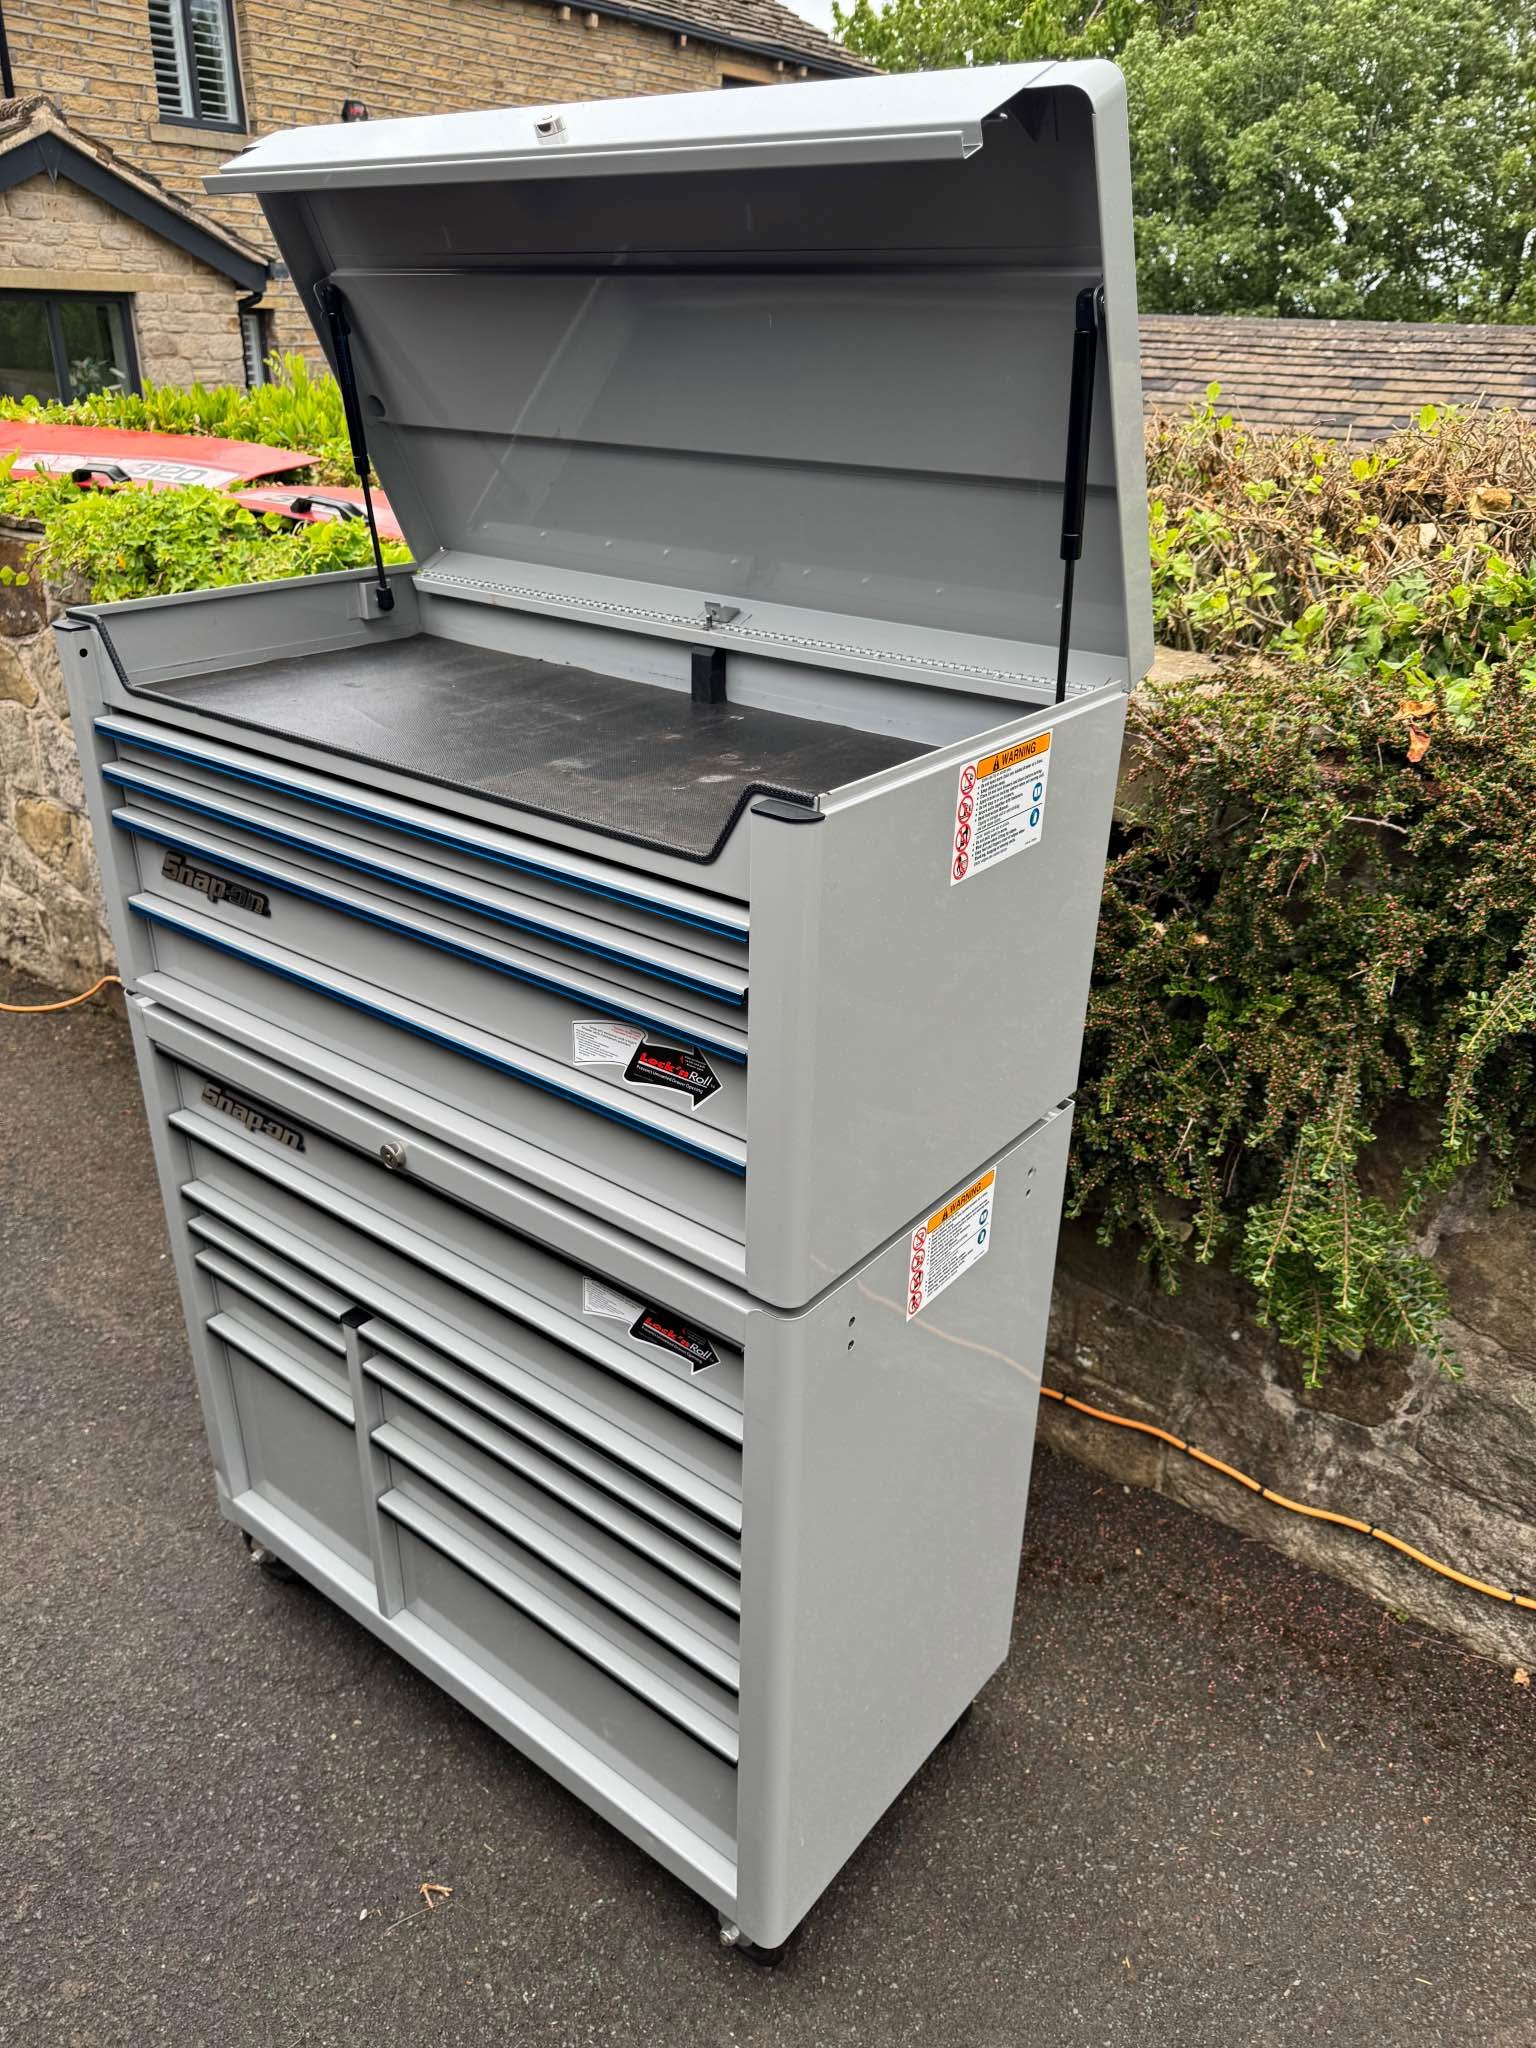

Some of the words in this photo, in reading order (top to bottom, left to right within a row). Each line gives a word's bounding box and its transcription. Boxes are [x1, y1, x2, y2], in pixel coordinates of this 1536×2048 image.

[1002, 742, 1037, 766] WARNING
[161, 850, 271, 918] Snap-on
[689, 1071, 713, 1087] Roll
[202, 1082, 305, 1153] Snap-on
[950, 1182, 982, 1213] WARNING
[689, 1343, 712, 1359] Roll
